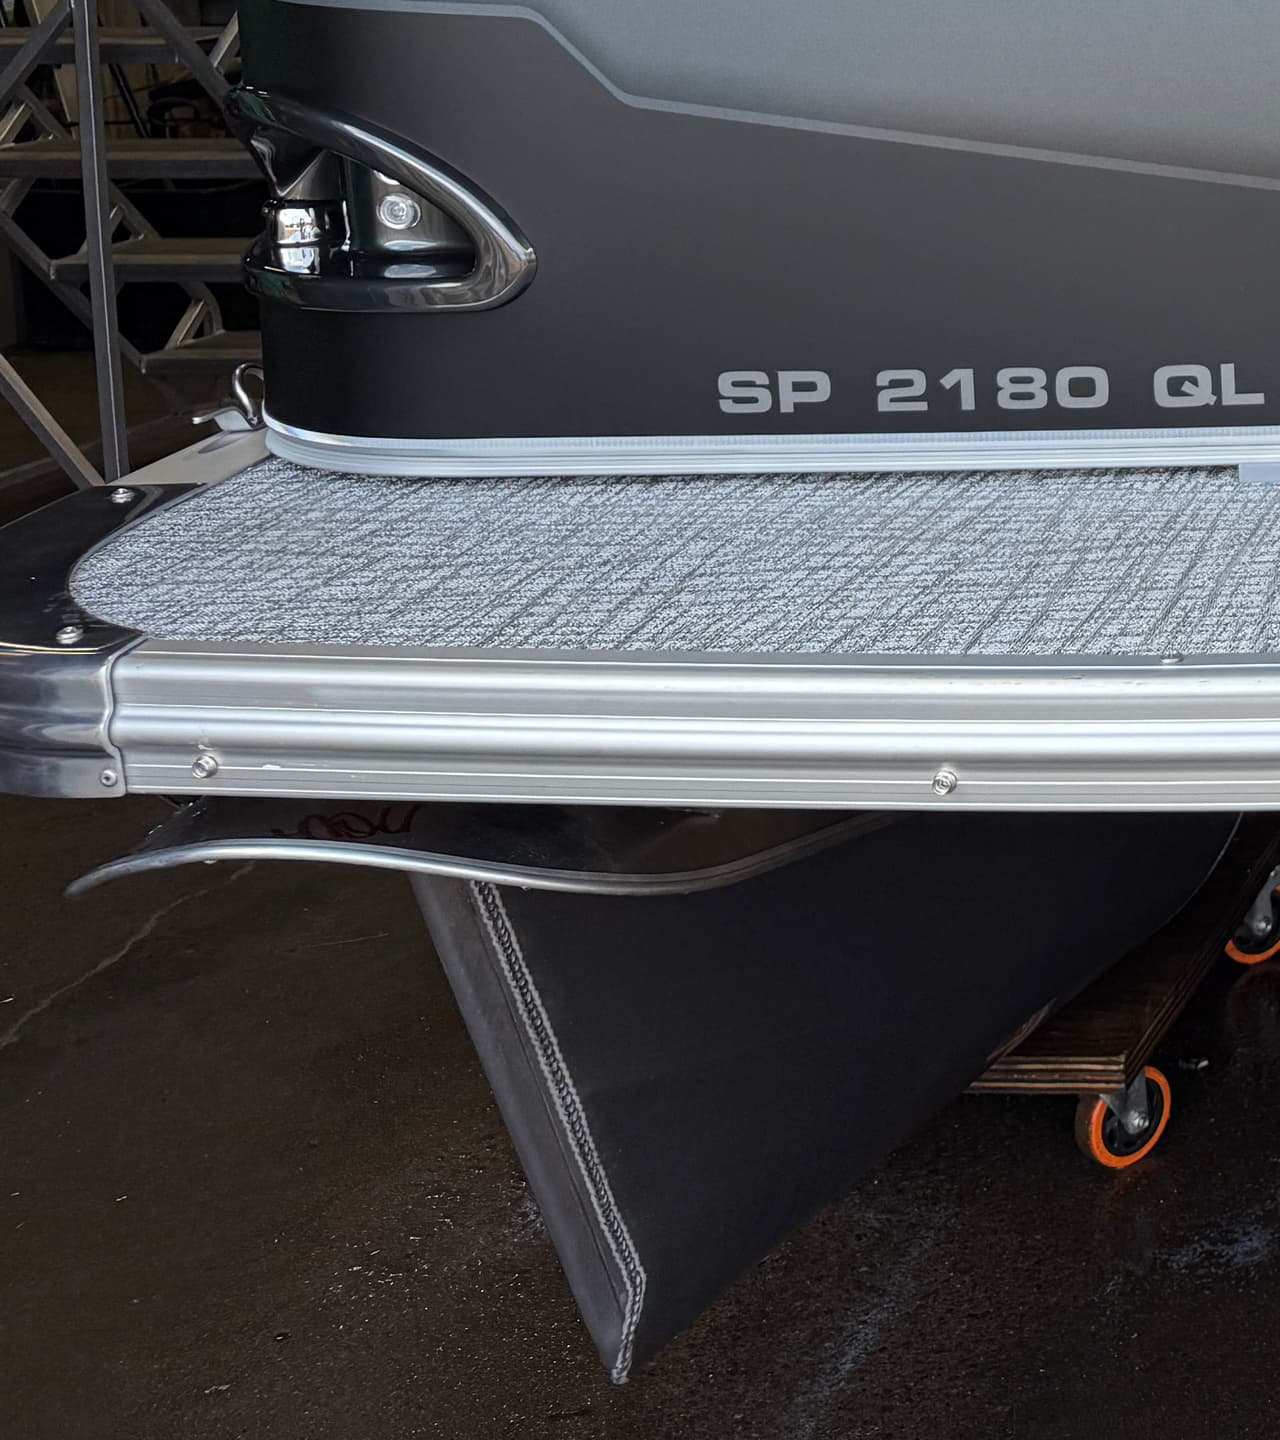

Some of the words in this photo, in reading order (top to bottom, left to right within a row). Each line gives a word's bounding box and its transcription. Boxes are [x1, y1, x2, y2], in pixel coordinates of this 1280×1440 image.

[716, 369, 832, 414] SP
[874, 365, 1110, 412] 2180
[1152, 361, 1266, 406] QL
